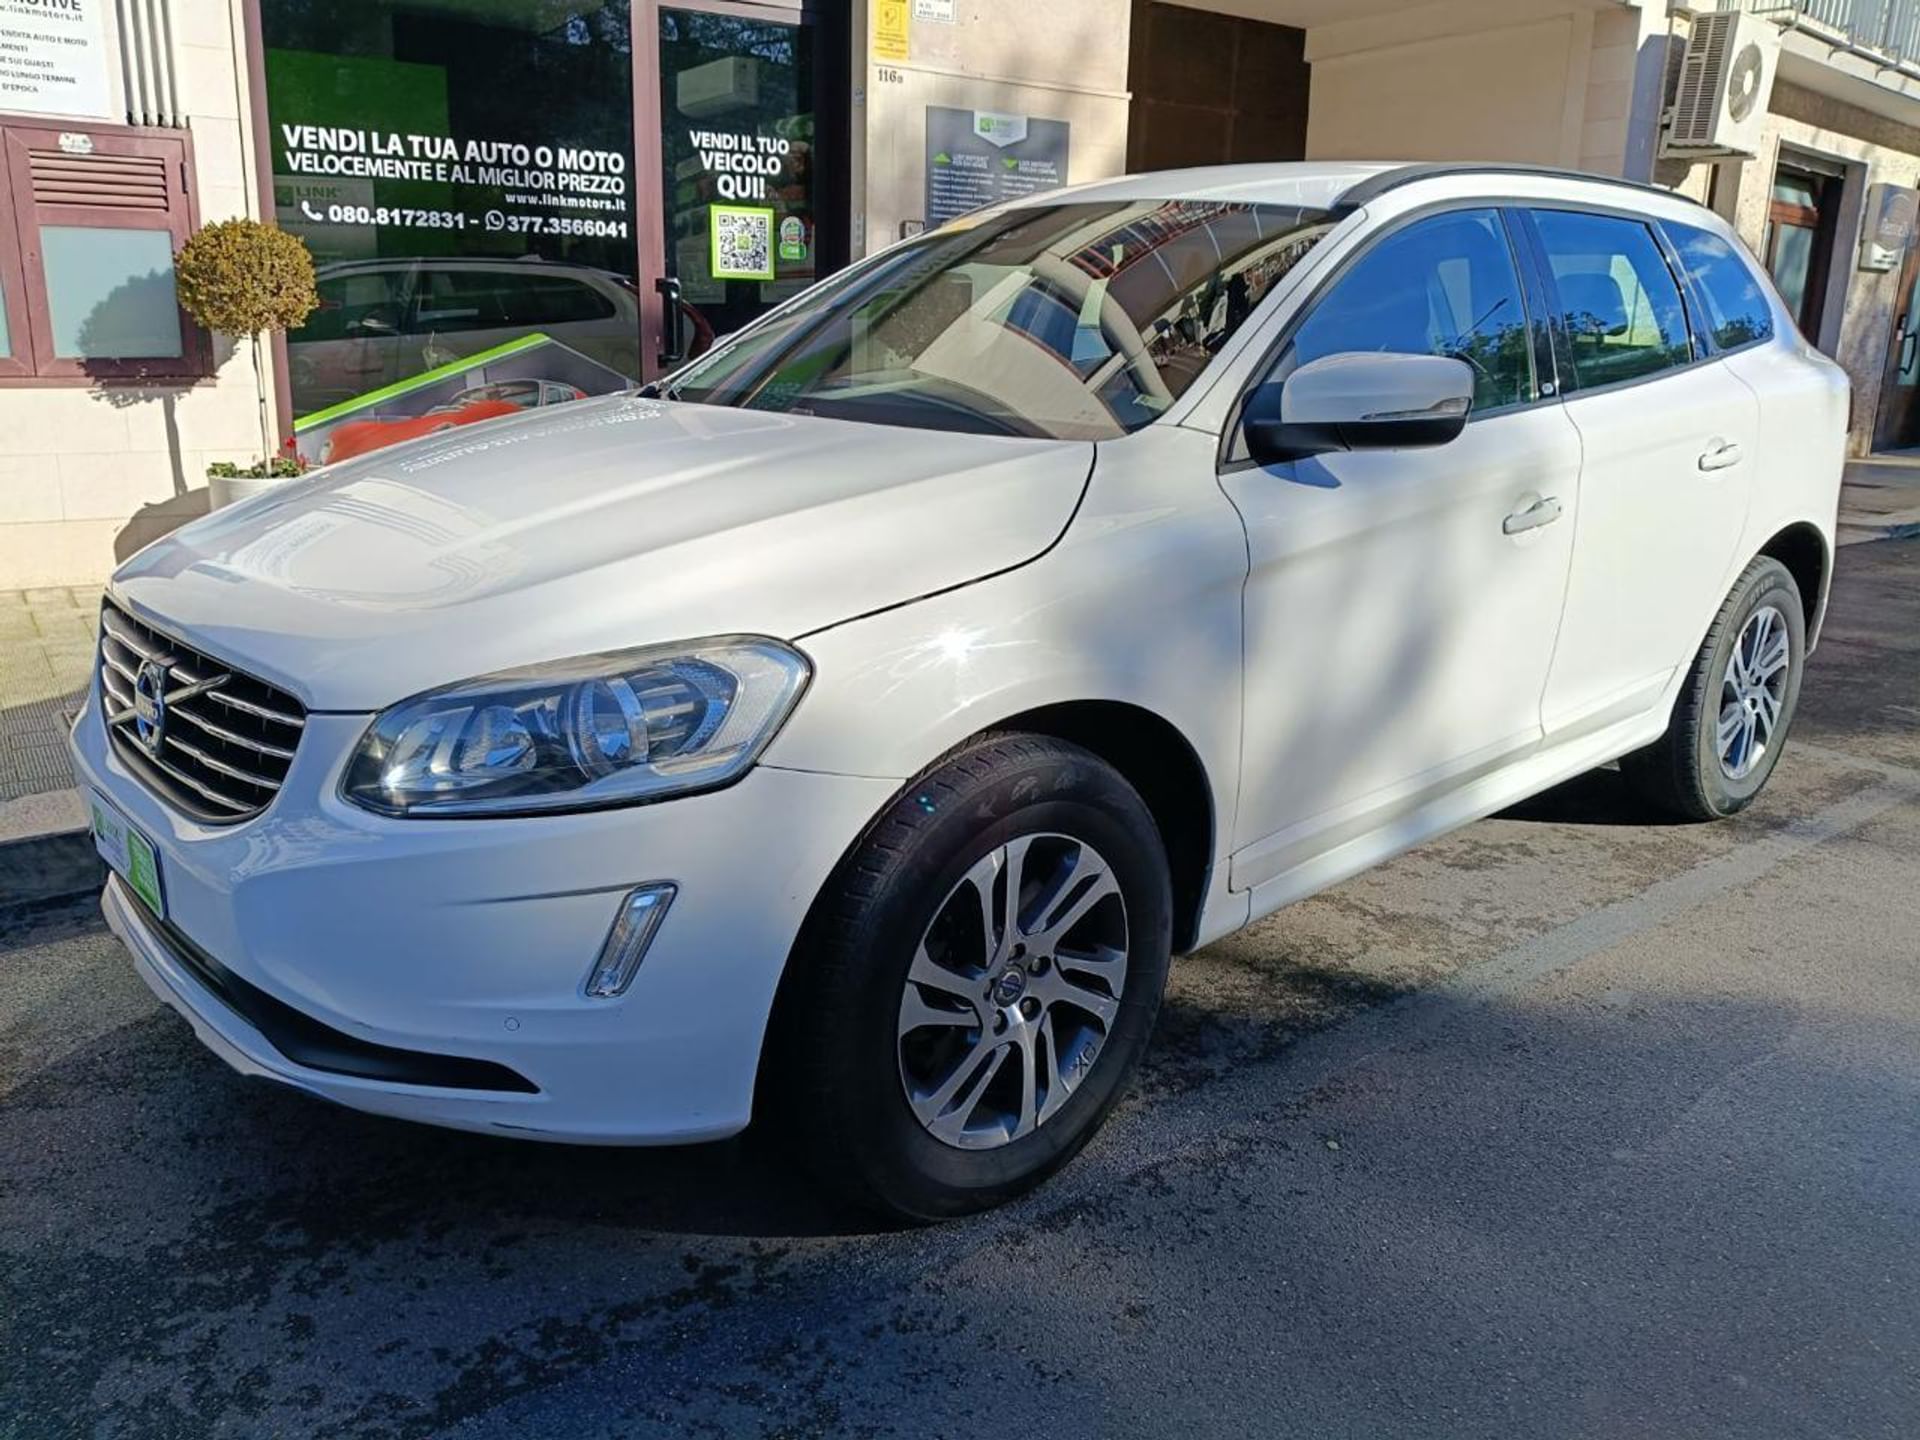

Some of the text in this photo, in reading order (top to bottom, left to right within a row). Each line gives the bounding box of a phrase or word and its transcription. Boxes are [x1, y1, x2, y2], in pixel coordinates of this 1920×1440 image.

[33, 33, 56, 43] AUTO
[64, 37, 88, 47] MOTO
[24, 58, 54, 69] GUASTI
[42, 73, 76, 85] TERMINE
[282, 123, 625, 174] VENDI LA TUA AUTO O MOTO
[689, 129, 790, 155] VENDI IL TUO
[286, 151, 625, 195] VELOCEMENTE E AL MIGLIOR PREZZO
[700, 149, 781, 175] VEICOLO
[717, 174, 765, 200] QUI!
[505, 193, 626, 212] www.linkmotors.it
[328, 204, 464, 230] 080.8172831
[507, 215, 628, 239] 377.3566041
